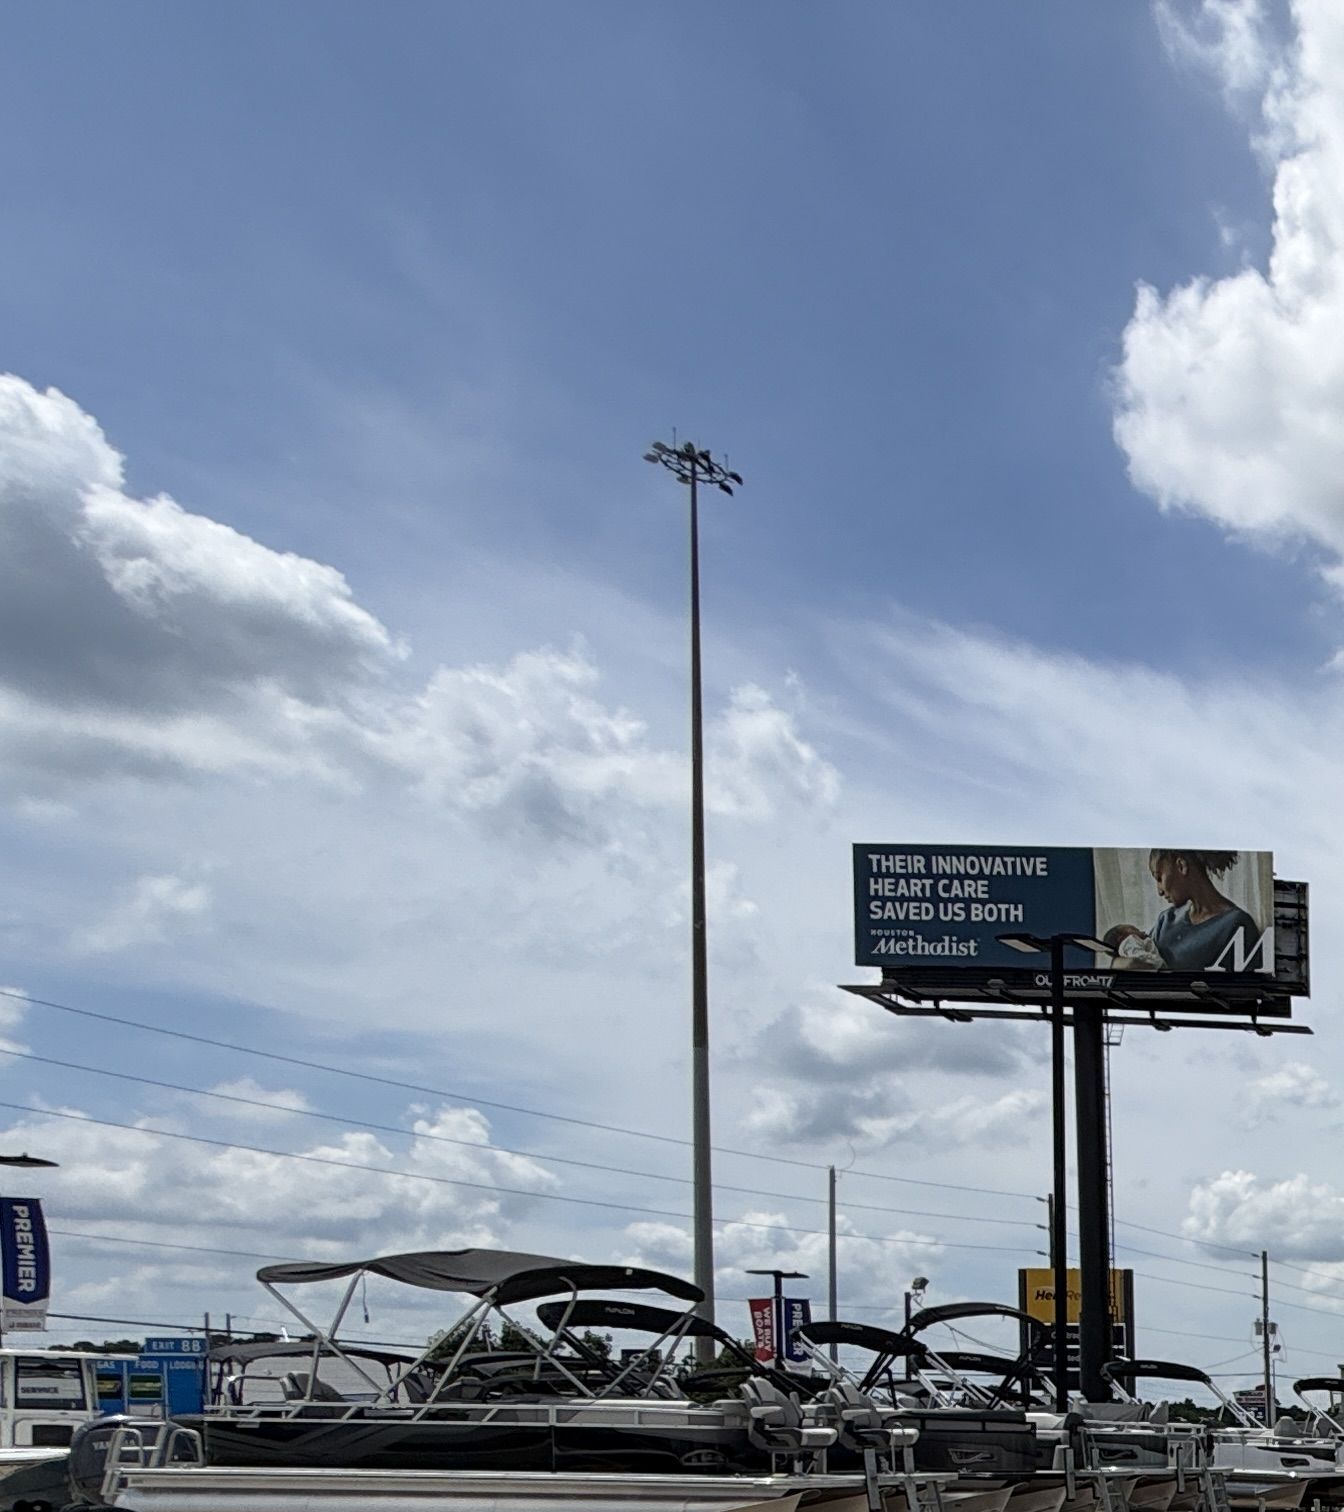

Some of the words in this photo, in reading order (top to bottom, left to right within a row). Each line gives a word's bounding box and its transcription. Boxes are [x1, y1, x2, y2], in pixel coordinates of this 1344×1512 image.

[868, 854, 926, 874] THEIR
[932, 855, 1048, 876] INNOVATIVE
[869, 877, 934, 898] HEART
[937, 879, 989, 899] CARE
[869, 900, 934, 921] SAVED
[939, 902, 966, 922] US
[970, 903, 1024, 923] BOTH
[870, 929, 915, 937] HOUSTON
[871, 935, 979, 957] Methodist
[12, 1205, 37, 1292] PREMIER
[763, 1307, 771, 1327] WE
[764, 1328, 772, 1351] BUY
[791, 1303, 804, 1355] PREER
[152, 1341, 175, 1350] EXIT
[182, 1340, 201, 1352] 88
[96, 1360, 115, 1369] GAS
[135, 1360, 160, 1369] FOOD
